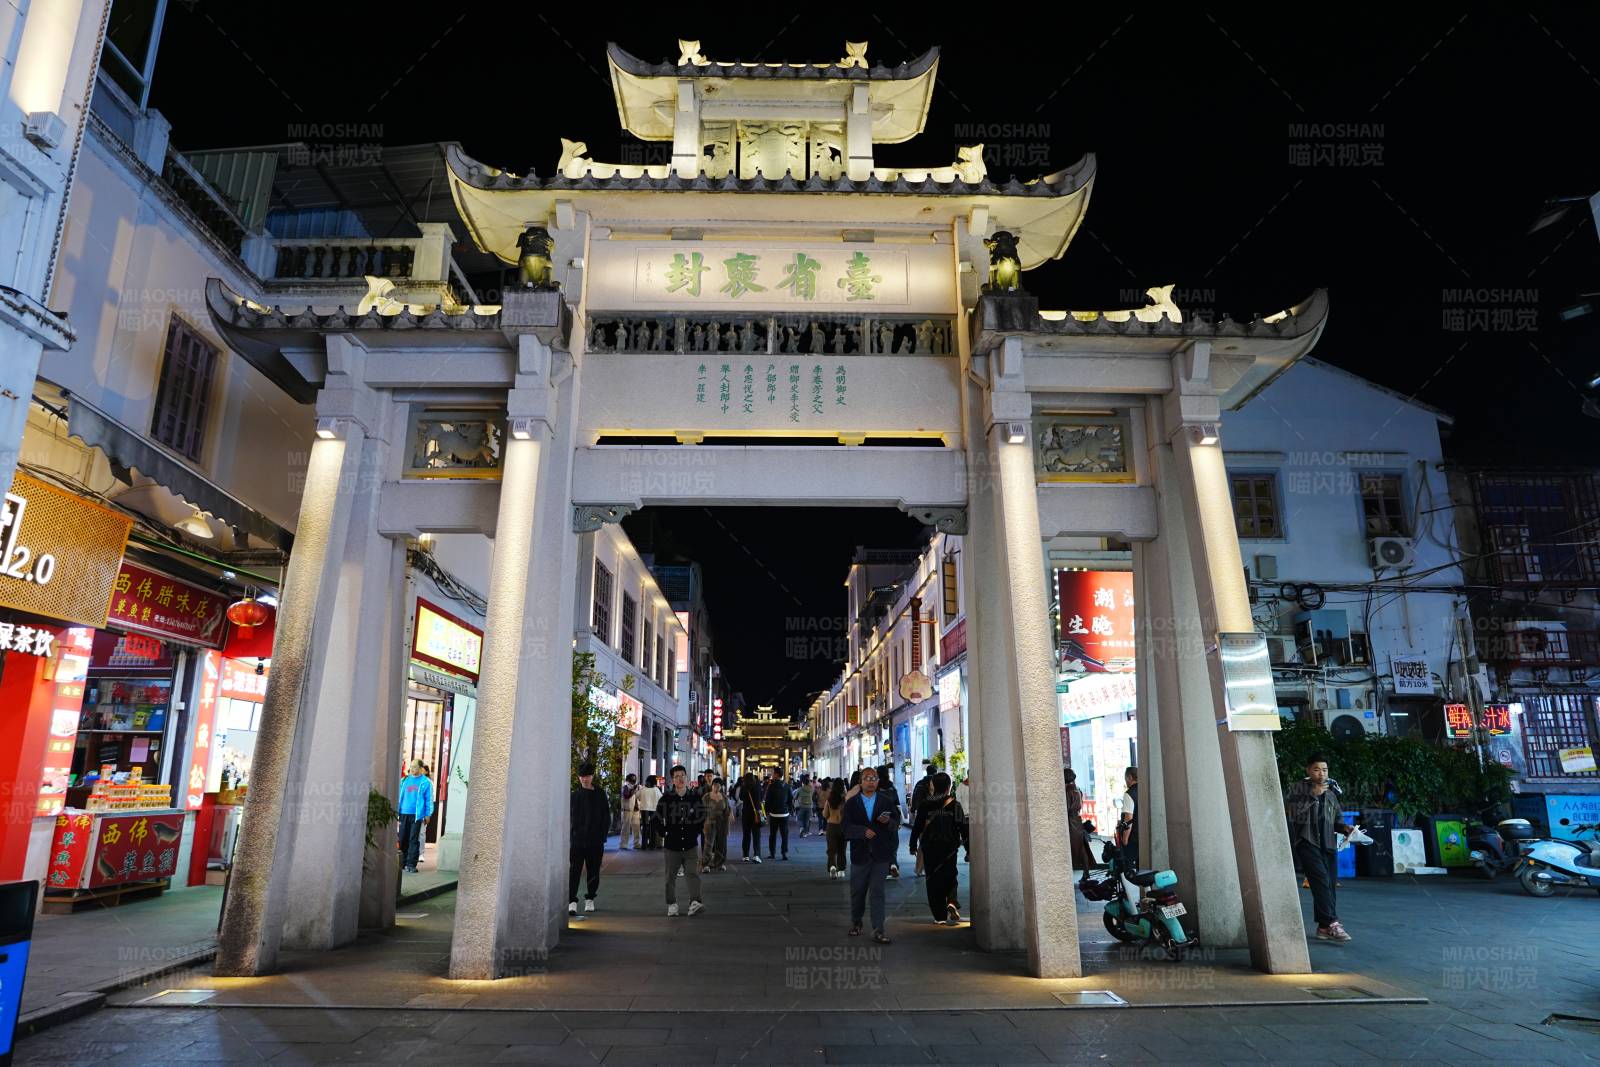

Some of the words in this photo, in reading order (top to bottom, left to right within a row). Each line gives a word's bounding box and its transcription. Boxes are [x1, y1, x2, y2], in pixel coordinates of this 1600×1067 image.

[7, 547, 55, 585] 2.0
[115, 573, 209, 618] 西伟腊味店
[1068, 614, 1114, 636] 生腌
[1563, 800, 1600, 811] 人人为创
[103, 817, 149, 849] 西伟
